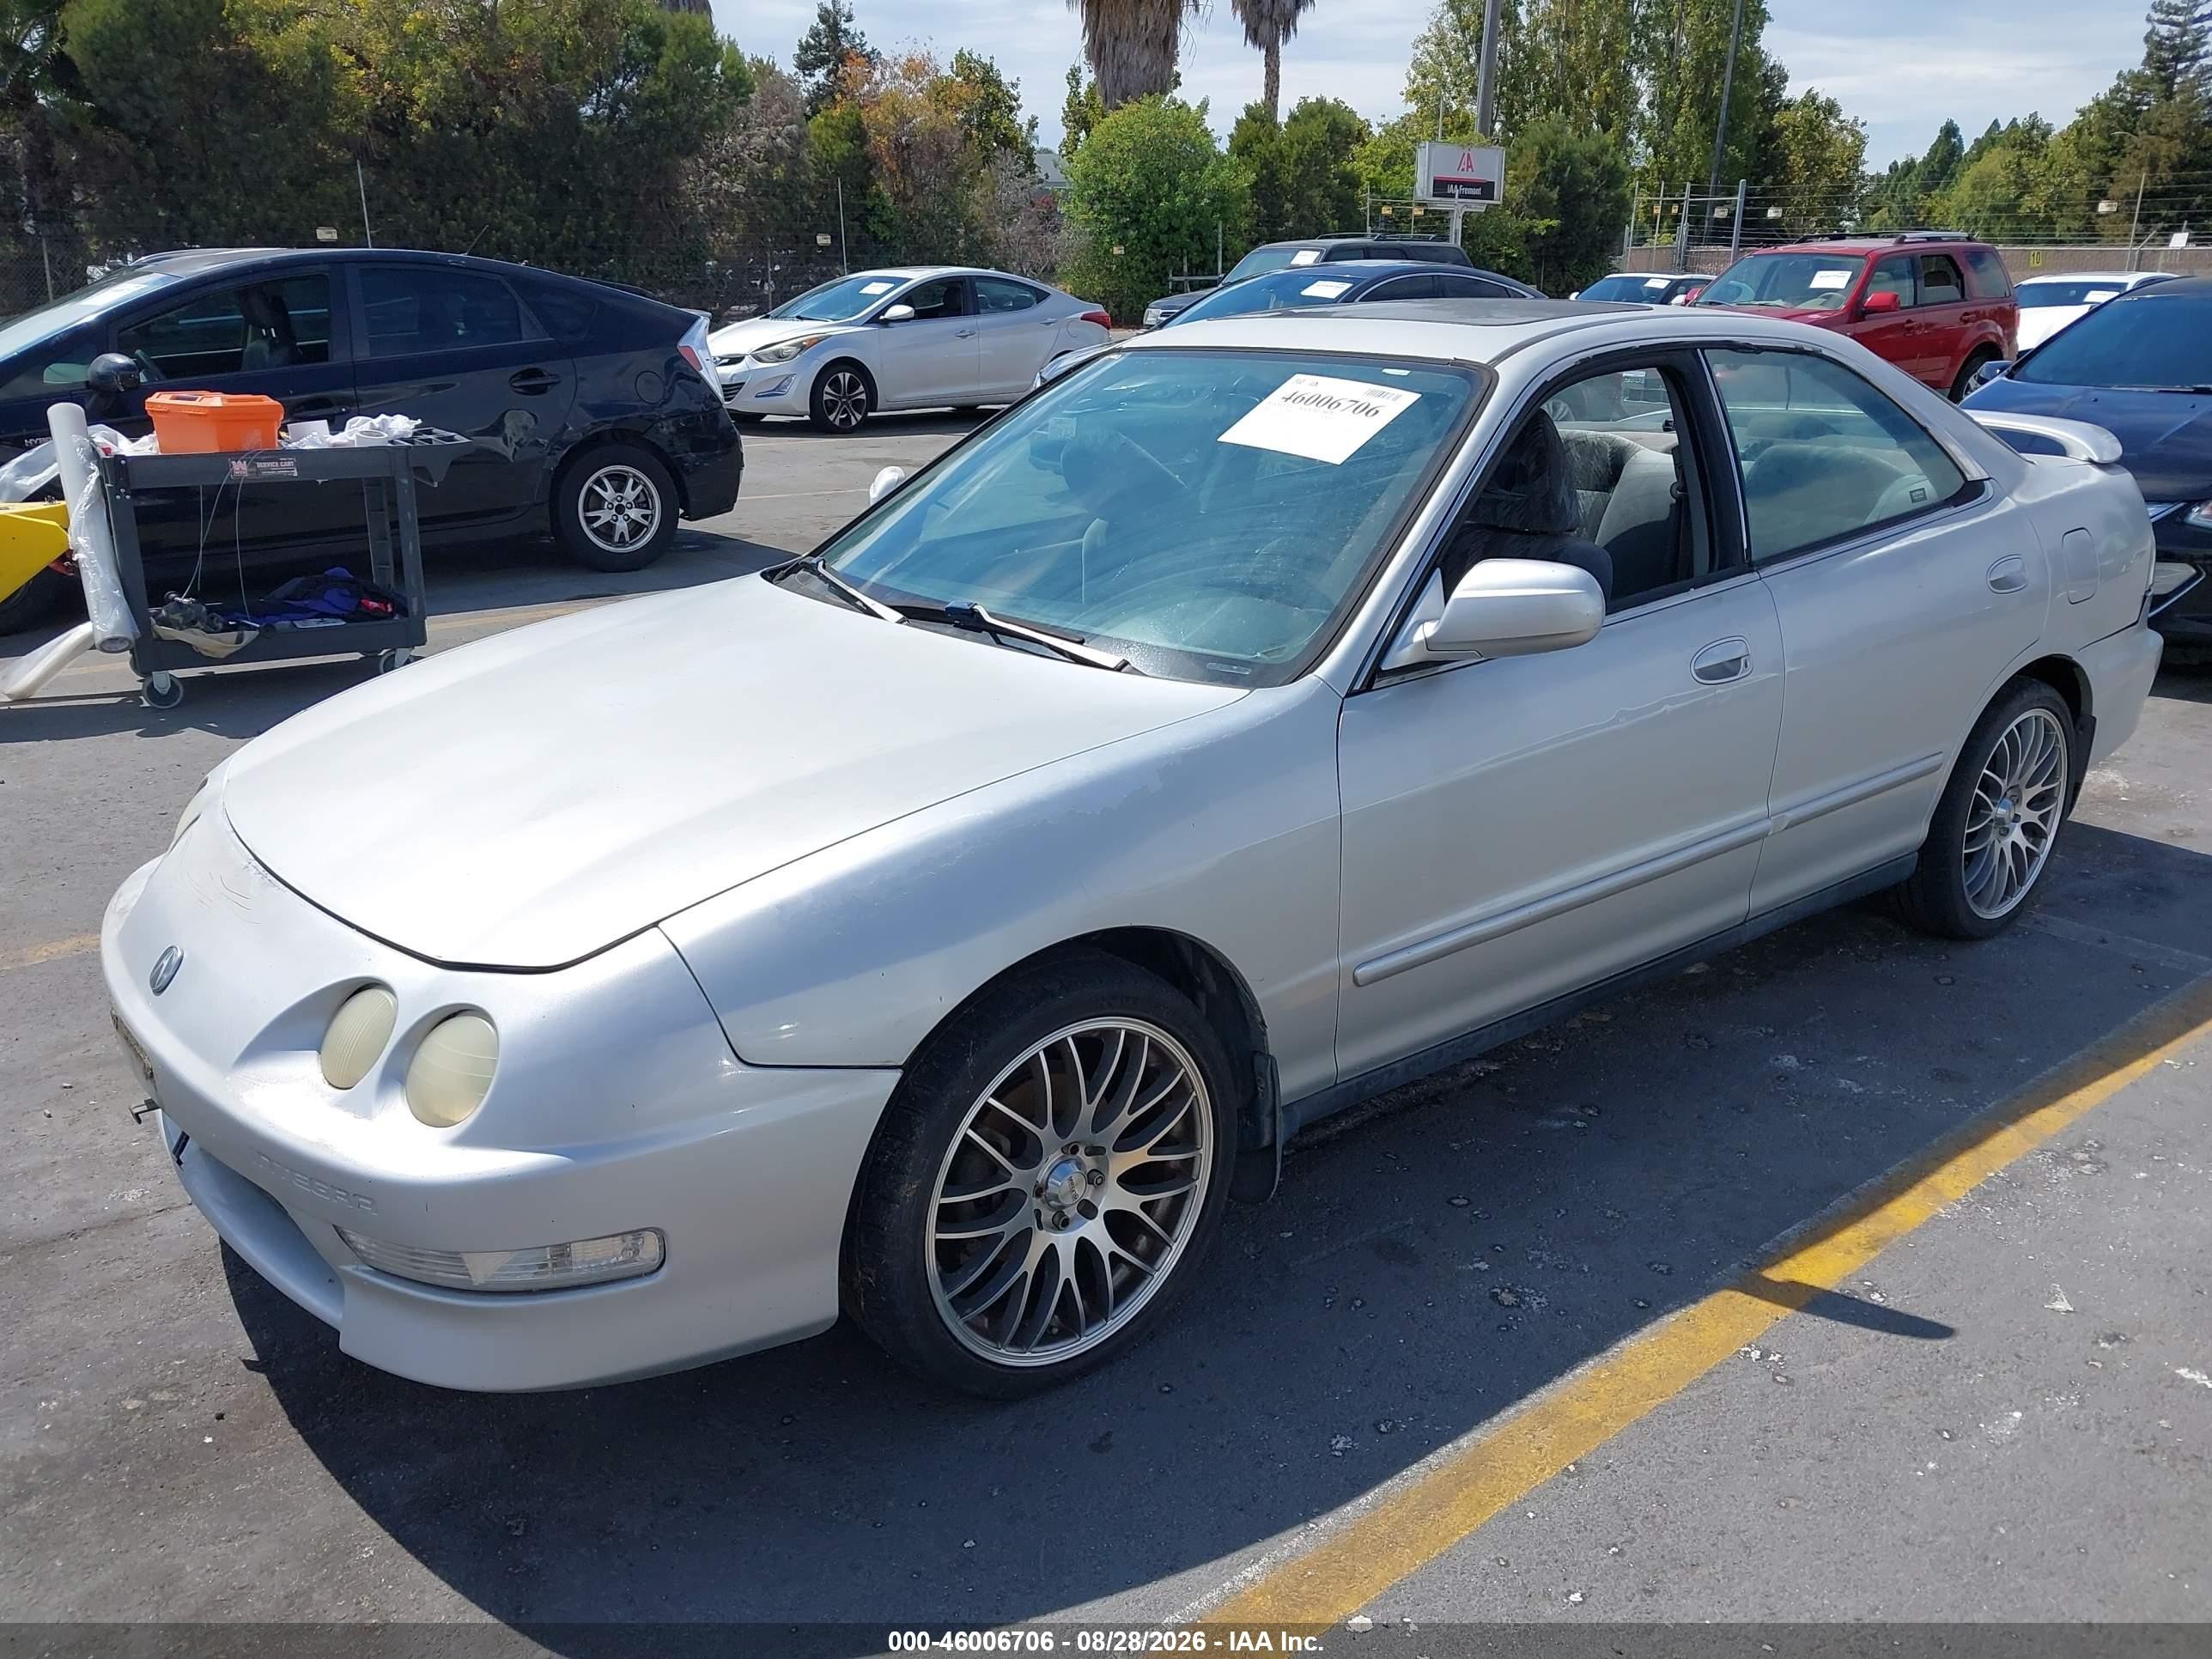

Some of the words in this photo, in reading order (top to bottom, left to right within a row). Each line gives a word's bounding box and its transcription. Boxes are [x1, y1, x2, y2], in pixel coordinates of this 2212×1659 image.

[1460, 185, 1481, 195] Fremont
[2032, 252, 2040, 264] 10
[1281, 391, 1387, 417] 46006706
